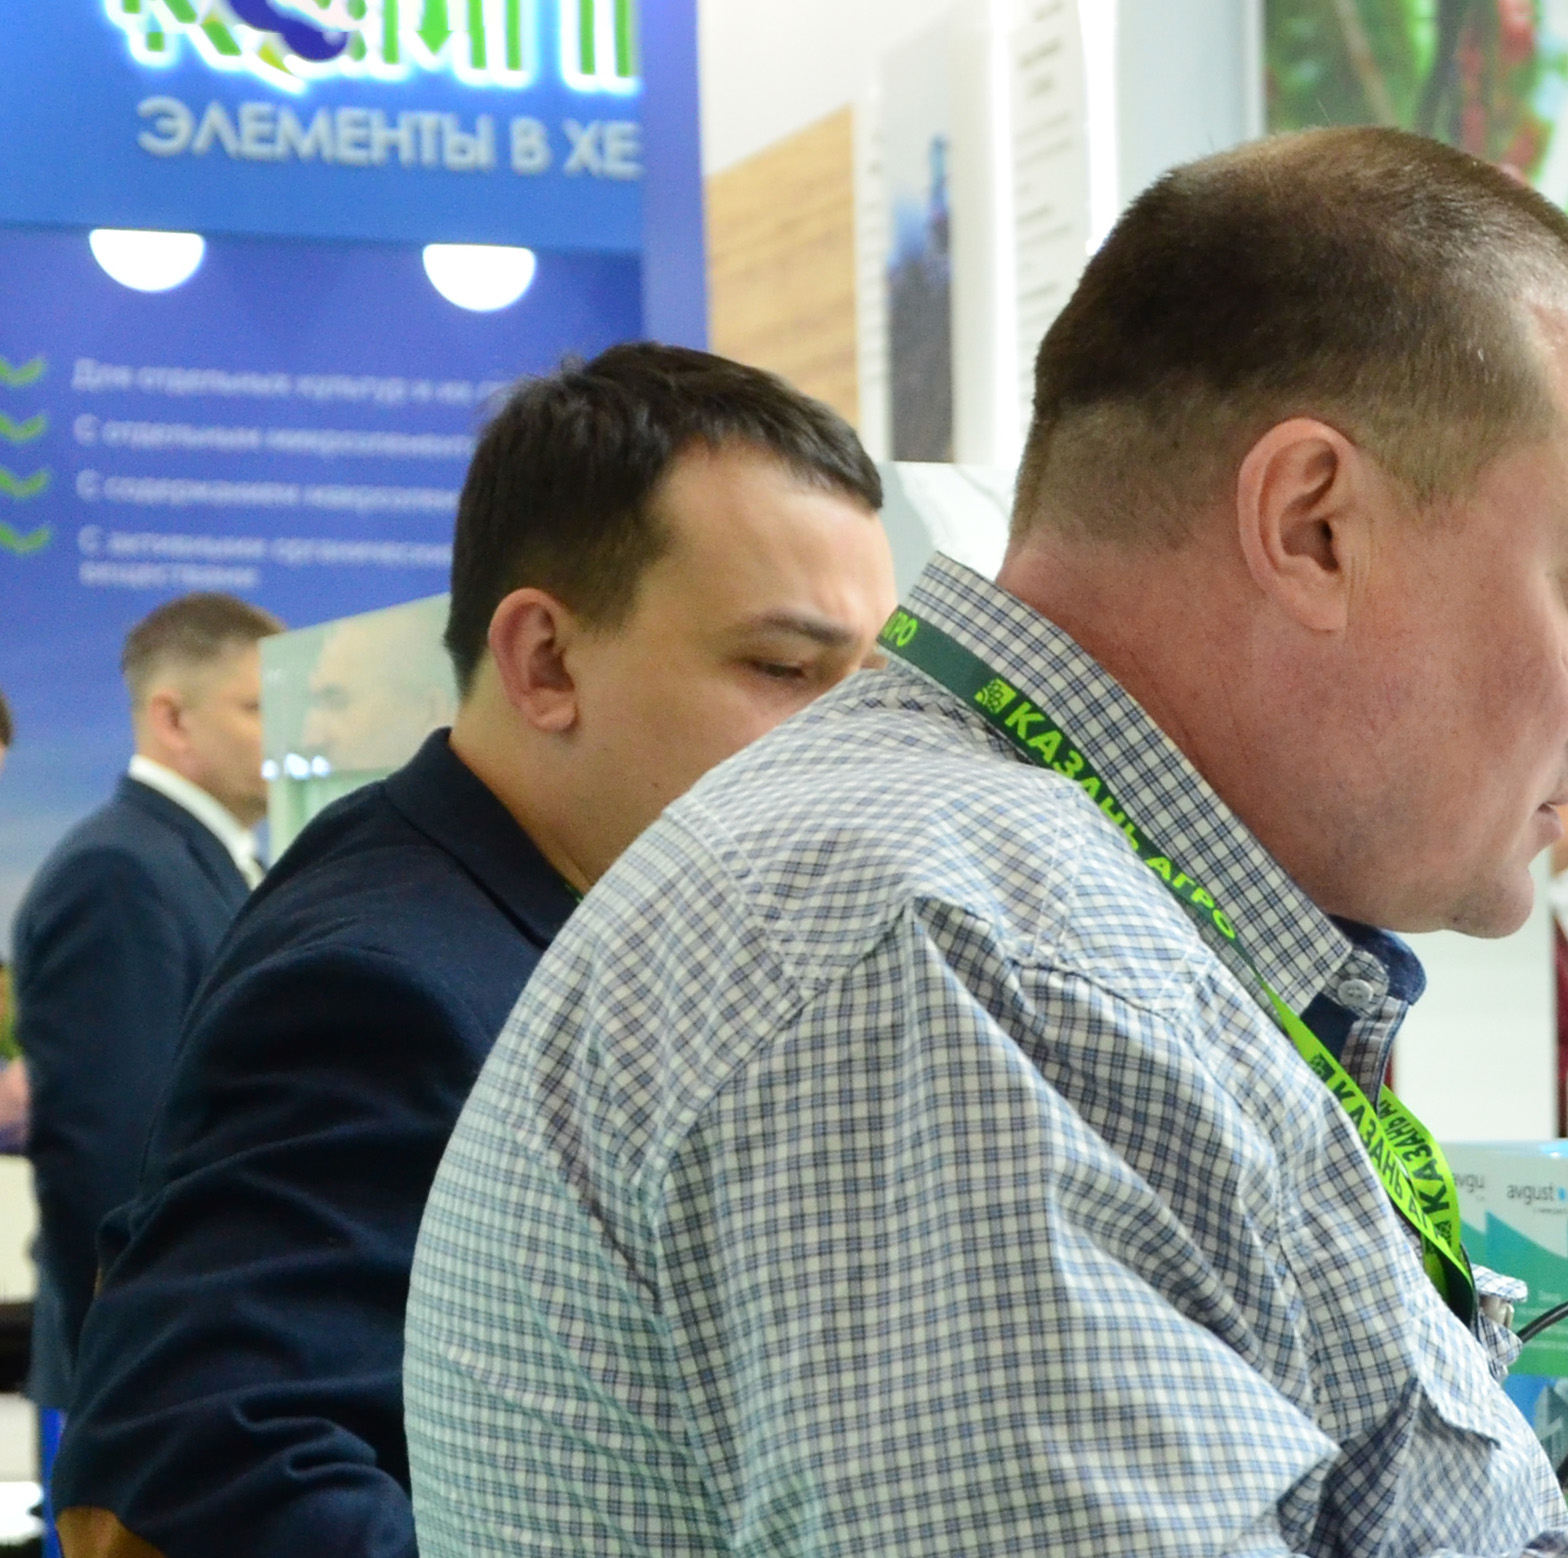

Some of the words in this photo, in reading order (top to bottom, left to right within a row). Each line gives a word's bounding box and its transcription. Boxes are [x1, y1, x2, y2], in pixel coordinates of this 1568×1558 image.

[136, 96, 495, 171] ЭЛЕМЕНТЫ
[509, 116, 552, 175] В
[1005, 701, 1139, 851] КАЗАНЬ
[1146, 856, 1236, 939] АГРО
[1506, 1183, 1554, 1206] avgust
